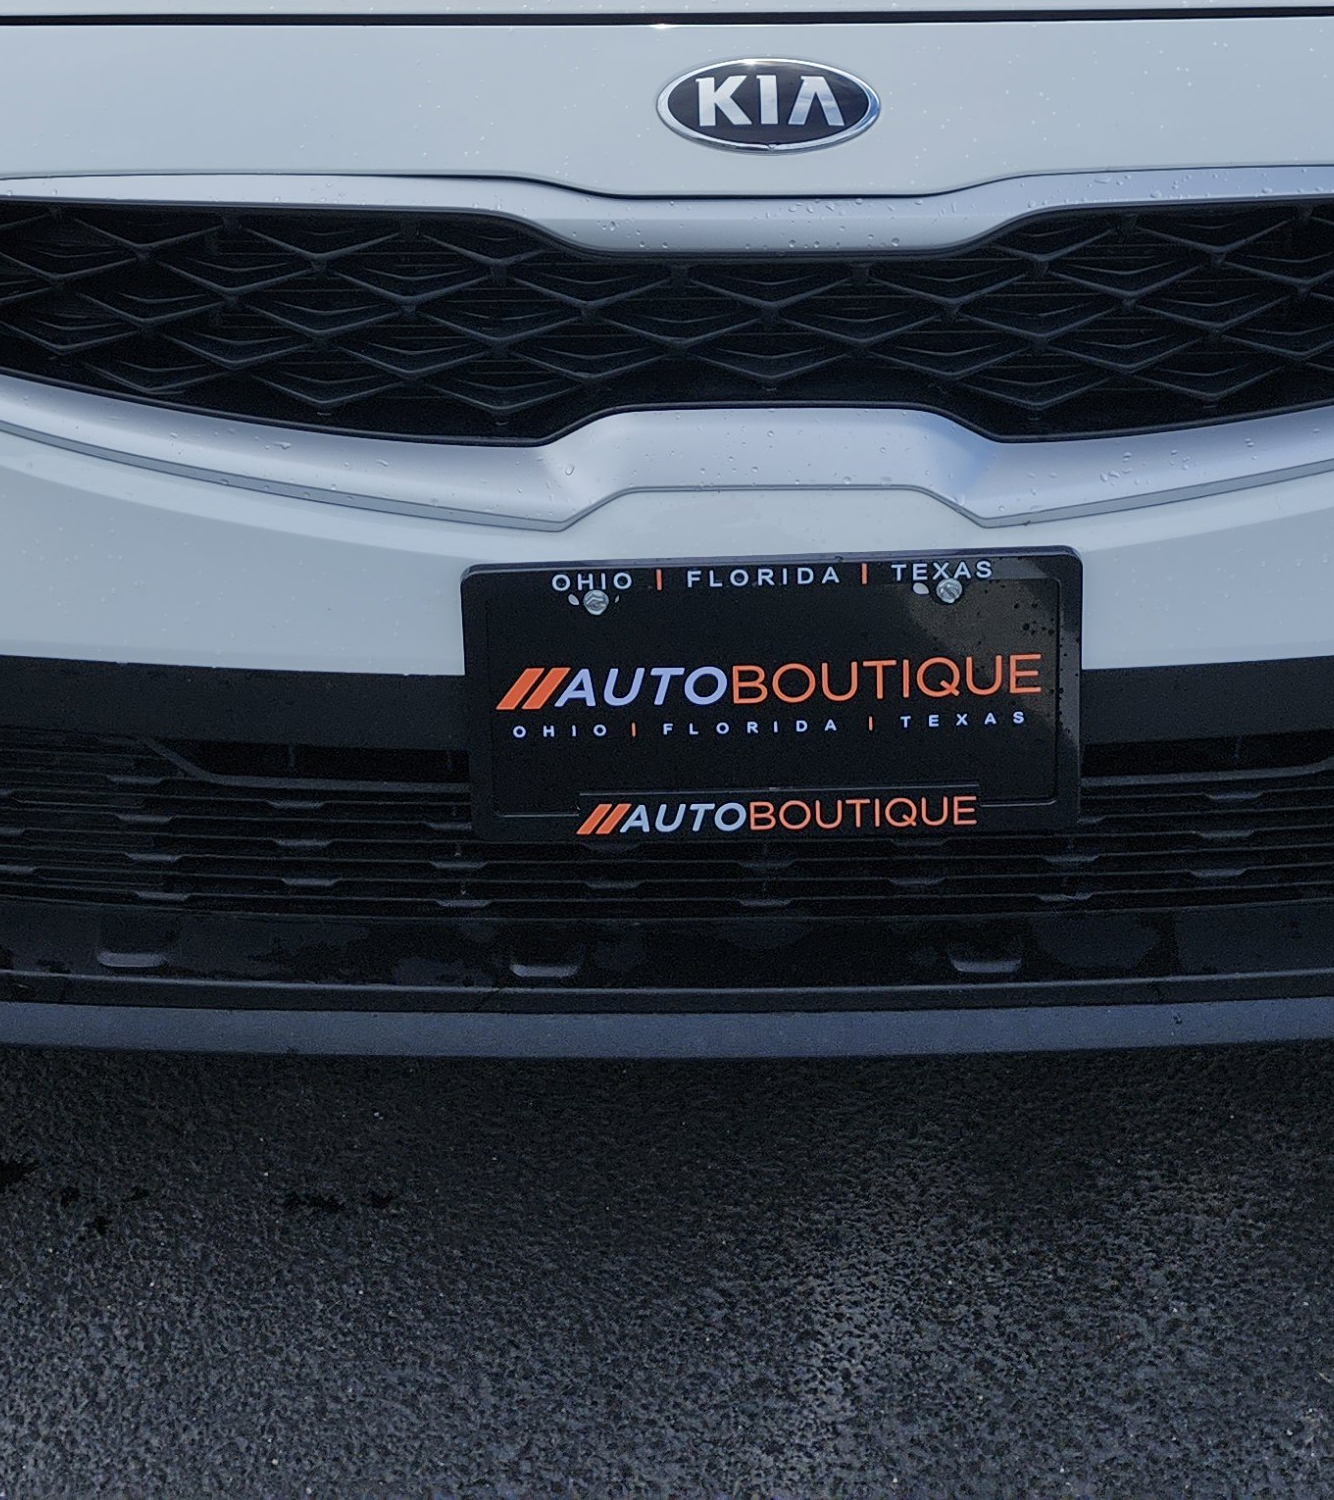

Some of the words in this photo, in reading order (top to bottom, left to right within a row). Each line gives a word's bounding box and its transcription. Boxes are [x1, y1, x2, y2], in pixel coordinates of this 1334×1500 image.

[695, 74, 845, 127] KIA
[551, 572, 633, 592] OHIO
[686, 566, 840, 588] FLORIDA
[891, 560, 993, 581] TEXAS
[554, 653, 1042, 708] AUTOBOUTIQUE
[512, 723, 607, 738] OHIO
[662, 718, 838, 736] FLORIDA
[900, 711, 1025, 729] TEXAS
[619, 795, 978, 834] AUTOBOUTIQUE
